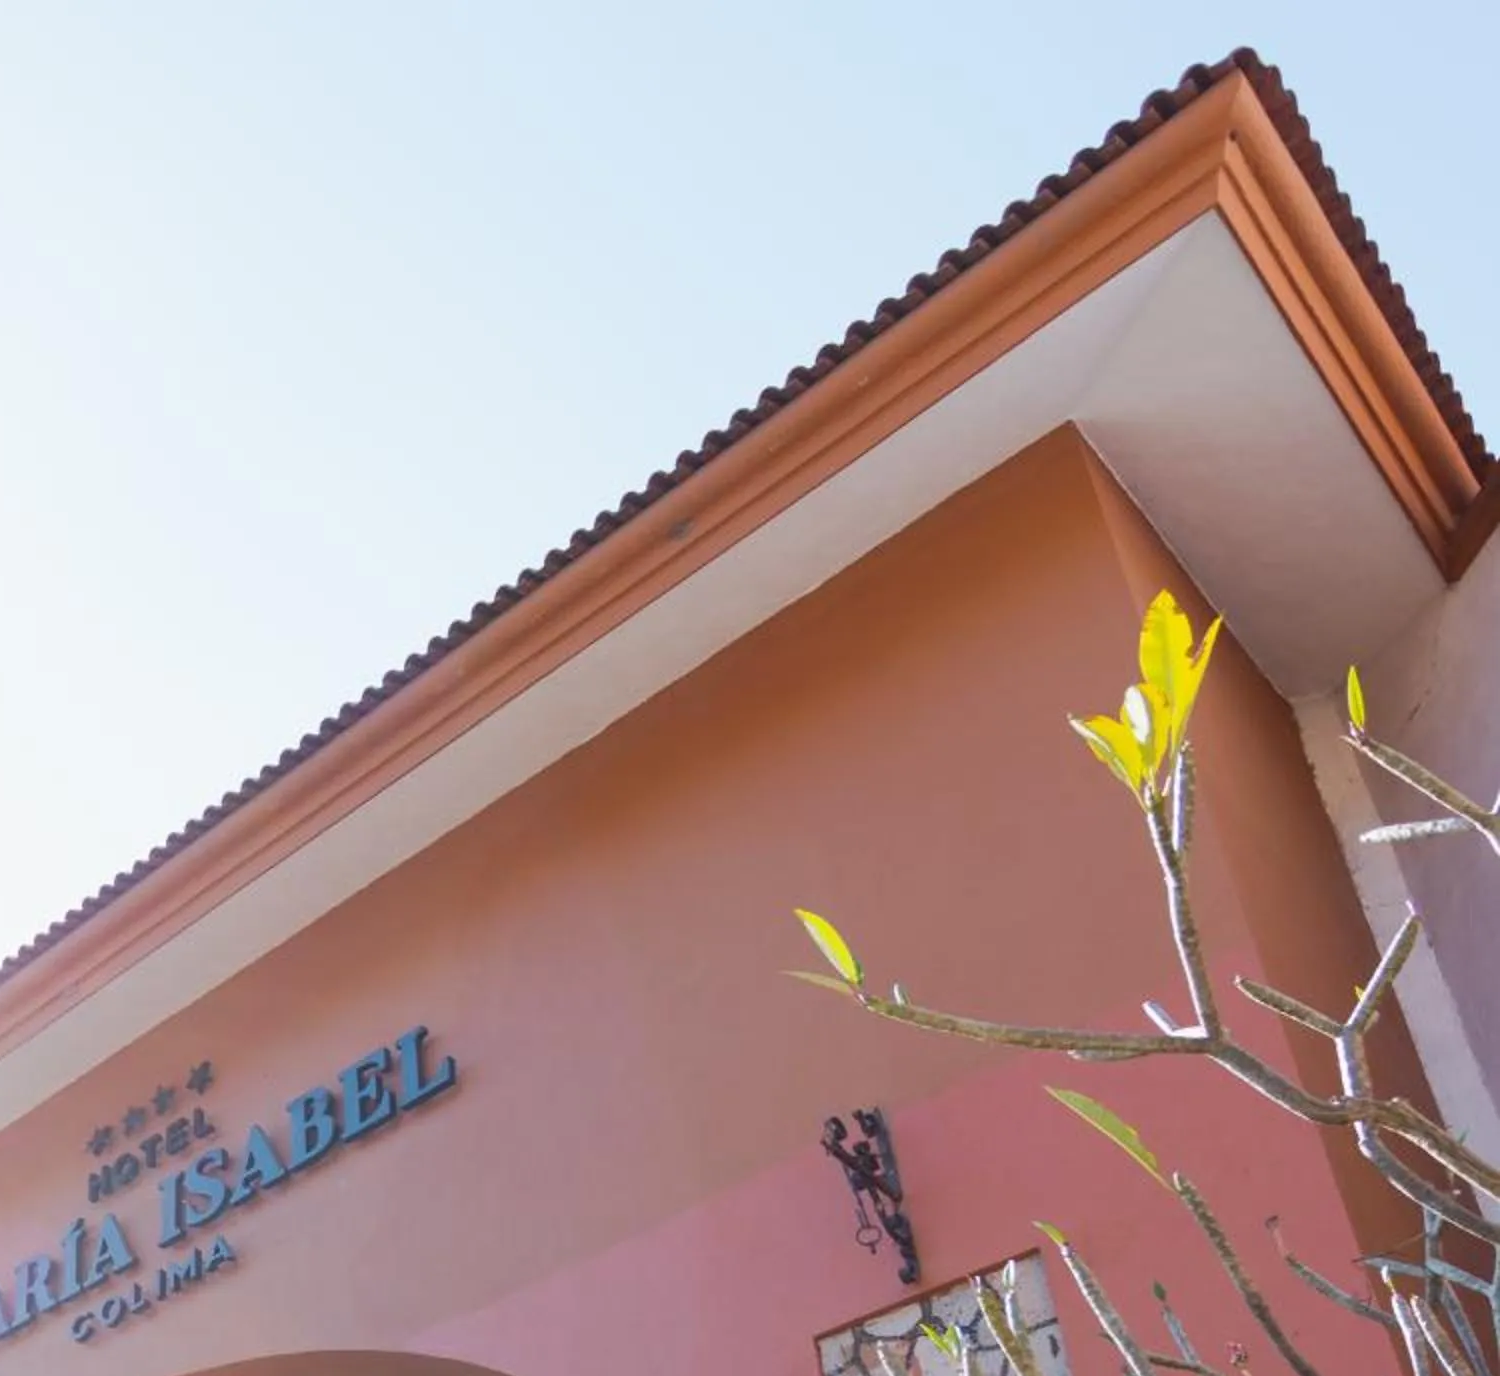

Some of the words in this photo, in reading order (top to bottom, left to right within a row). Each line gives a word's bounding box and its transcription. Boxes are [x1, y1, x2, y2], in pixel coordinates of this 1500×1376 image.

[87, 1107, 216, 1203] HOTEL
[157, 1025, 457, 1248] ISABEL
[71, 1234, 238, 1342] COLIMA
